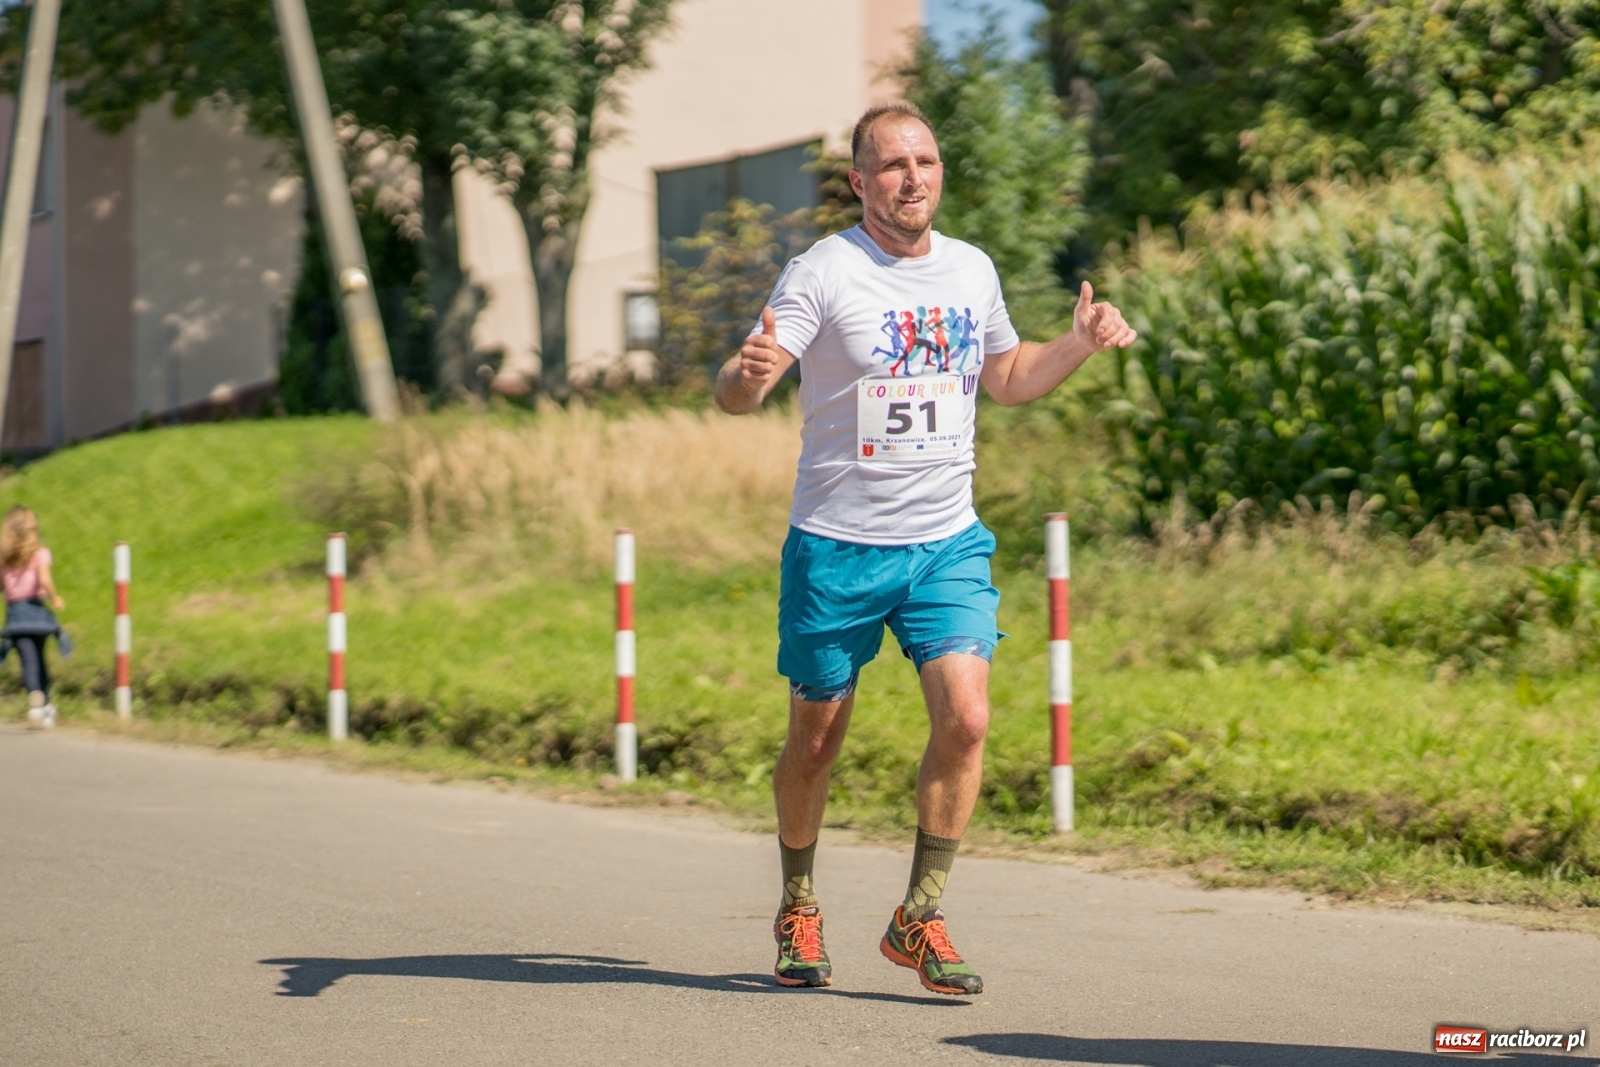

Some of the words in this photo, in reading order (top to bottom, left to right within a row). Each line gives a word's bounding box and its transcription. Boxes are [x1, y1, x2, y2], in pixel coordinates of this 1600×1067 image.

[867, 383, 925, 398] COLOUR
[931, 382, 955, 397] RUN
[885, 400, 936, 435] 51
[930, 434, 961, 442] 05.09.2021
